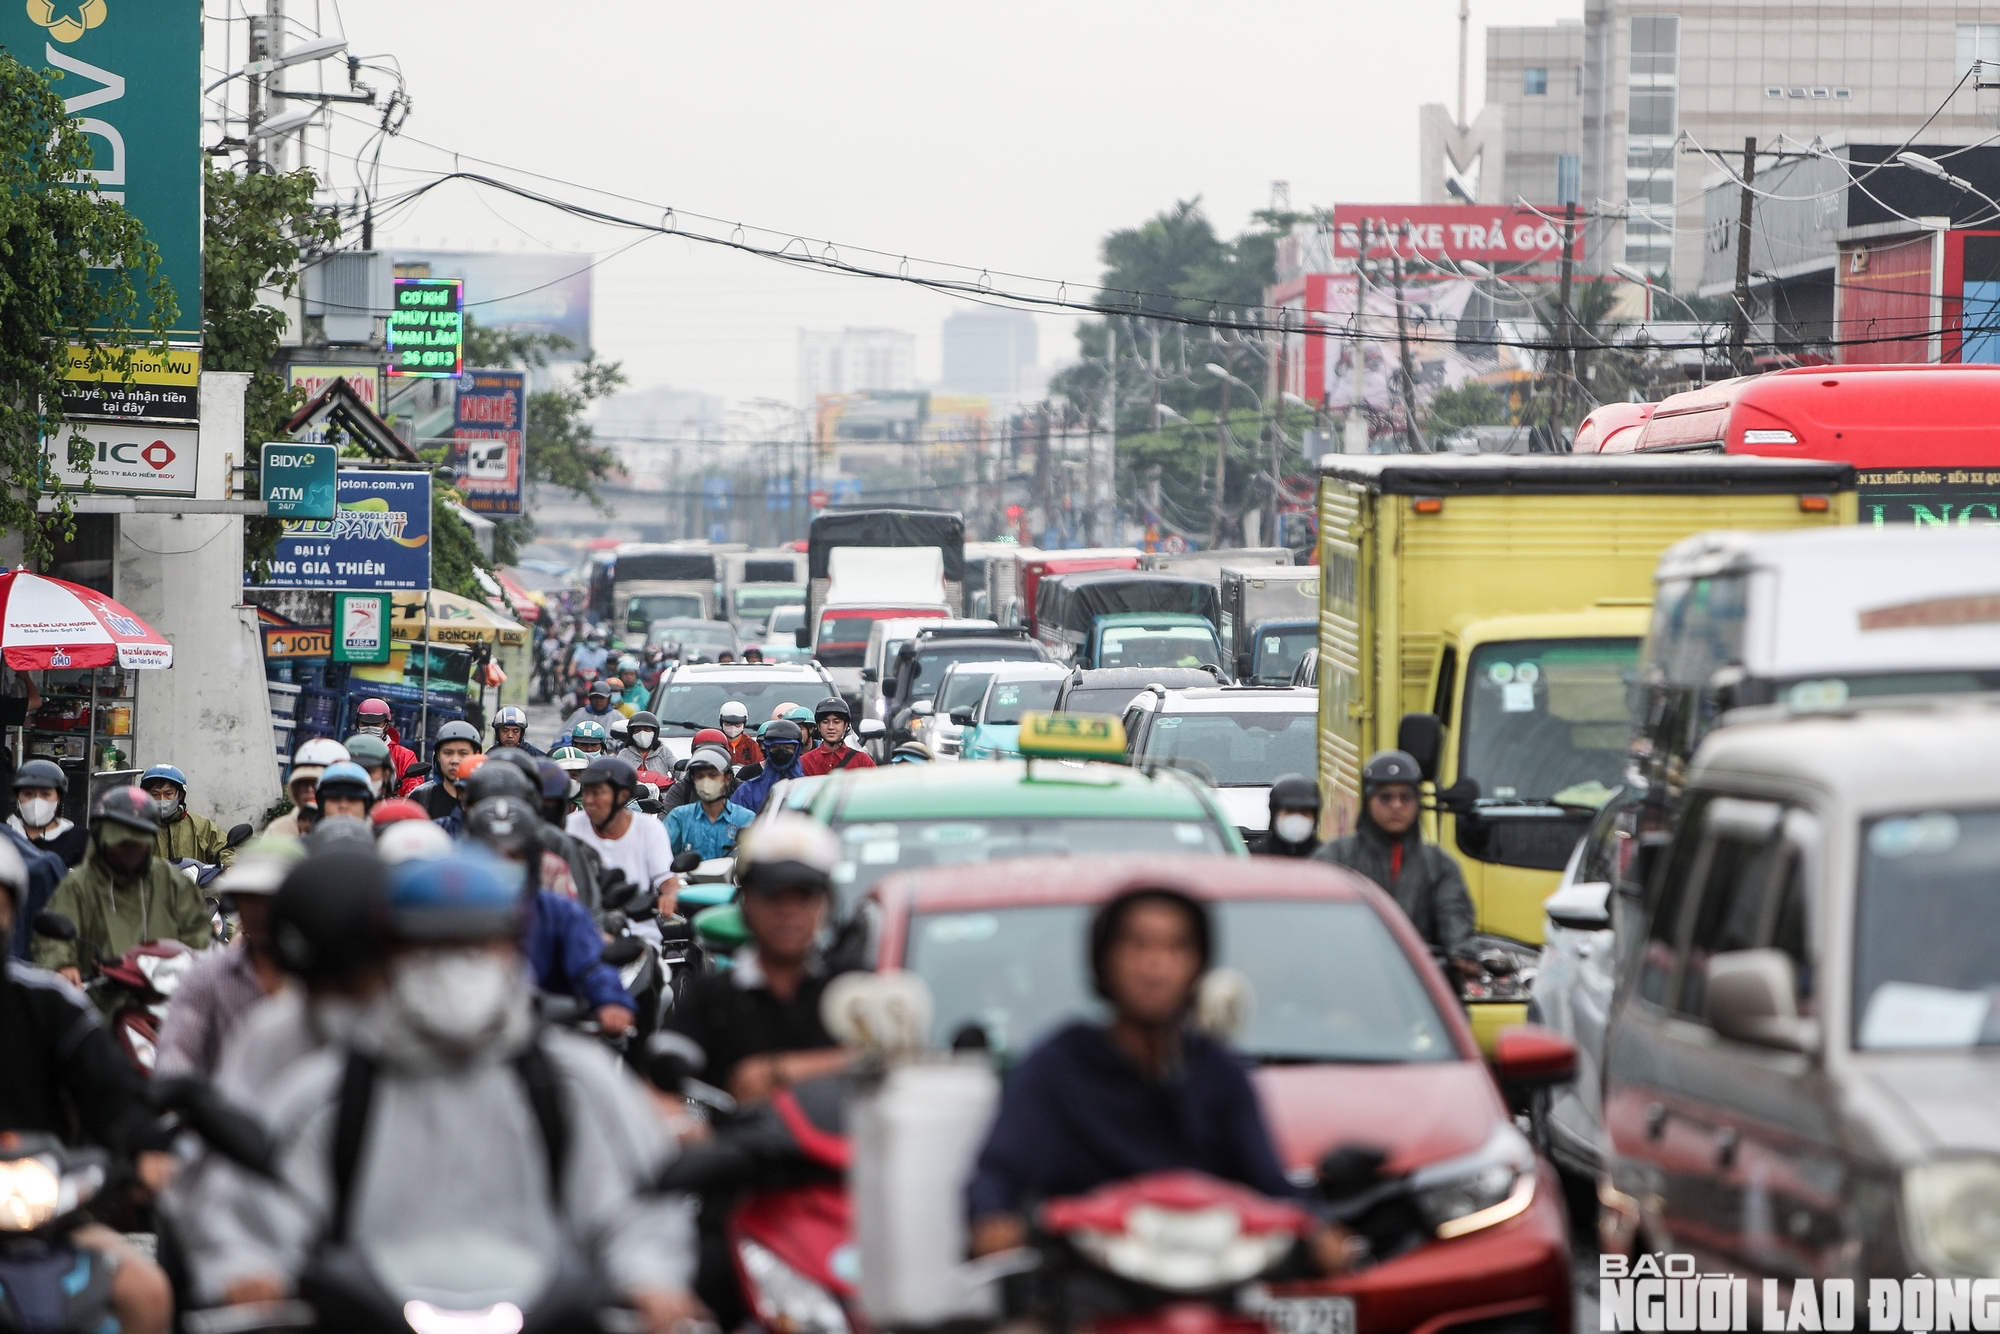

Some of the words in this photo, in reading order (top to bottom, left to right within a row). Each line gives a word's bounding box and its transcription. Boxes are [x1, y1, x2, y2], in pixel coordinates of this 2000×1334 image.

[1403, 222, 1445, 249] XE
[1449, 218, 1507, 250] TRẢ
[166, 362, 192, 375] WU
[111, 389, 125, 400] và
[128, 390, 159, 403] nhận
[162, 391, 187, 403] tiền
[103, 401, 119, 414] tại
[122, 402, 146, 415] đây
[460, 390, 517, 428] NGHỆ
[270, 455, 303, 467] BIDV
[1869, 474, 1883, 484] XE
[1885, 470, 1911, 485] MIỀN
[1912, 471, 1942, 484] ĐÔNG
[1947, 470, 1969, 483] BẾN
[1970, 472, 1984, 483] XE
[269, 487, 303, 500] ATM
[294, 545, 314, 557] ĐẠI
[317, 544, 331, 555] LÝ
[302, 561, 331, 575] GIA
[335, 559, 385, 575] THIÊN
[106, 617, 146, 636] OMO
[438, 630, 483, 640] BONCHA
[52, 656, 70, 666] OMO
